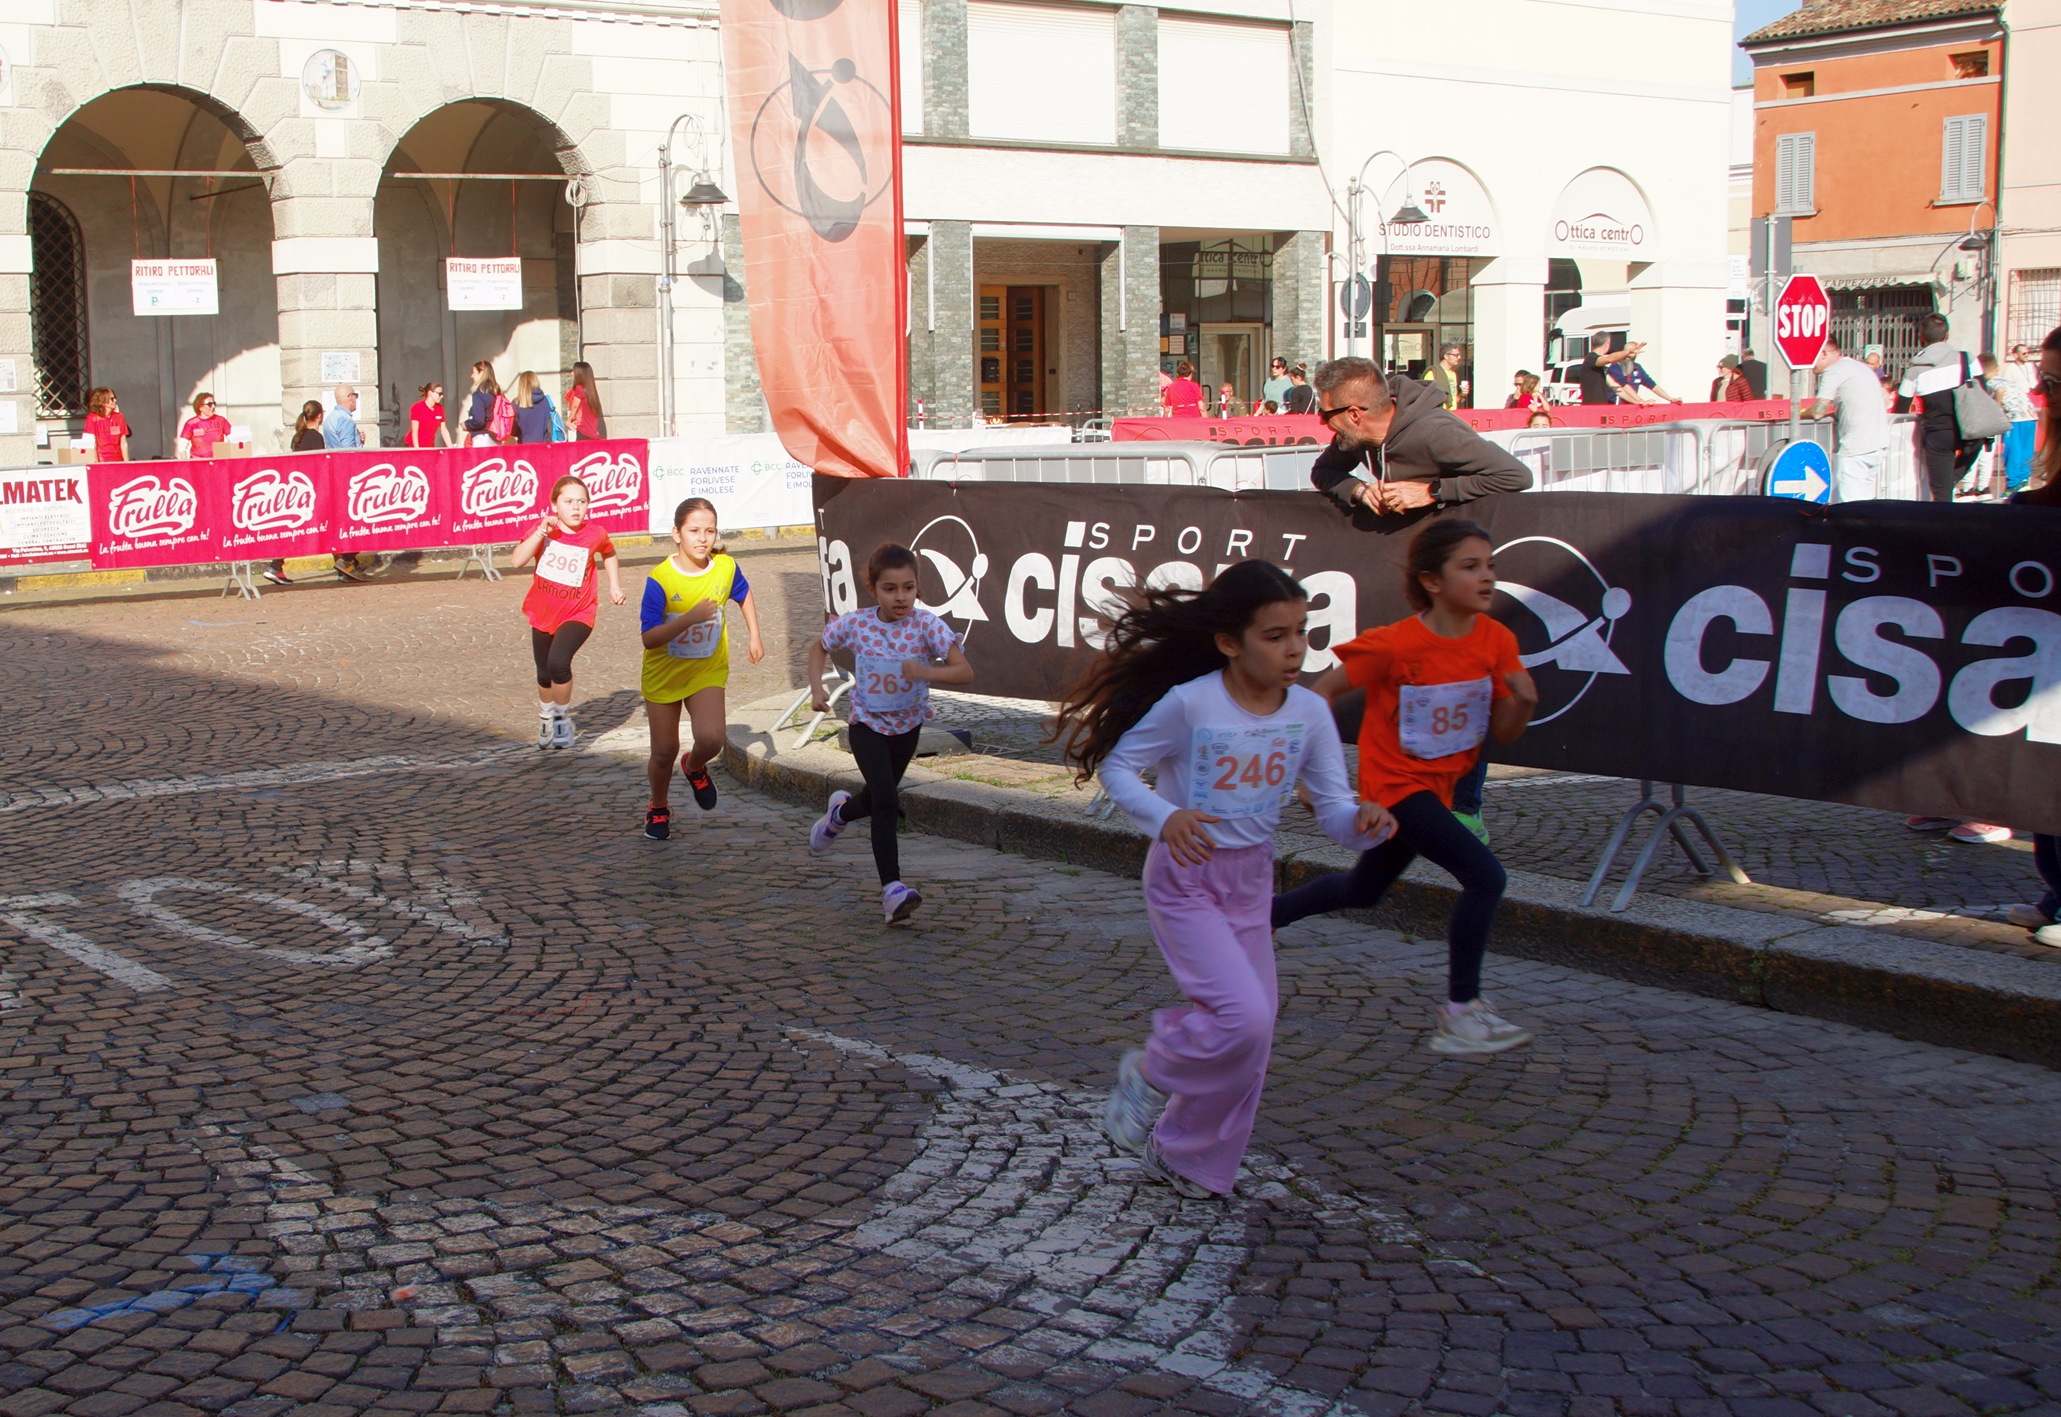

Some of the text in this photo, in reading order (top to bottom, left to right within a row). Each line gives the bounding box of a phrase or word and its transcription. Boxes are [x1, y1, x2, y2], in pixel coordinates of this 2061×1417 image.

[1378, 222, 1490, 239] STUDIO DENTISTICO
[1555, 219, 1595, 241] Ottica
[1417, 244, 1450, 252] Annamaria
[1451, 244, 1480, 252] Lombardi
[136, 265, 214, 277] RITIRO PETTORALI
[450, 262, 477, 273] RITIRO
[1823, 276, 1897, 288] TAPPEZZERIA
[1778, 304, 1827, 338] STOP
[1608, 414, 1668, 425] SPORT
[1218, 425, 1292, 437] SPORT
[667, 467, 684, 476] BCC
[690, 466, 740, 475] RAVENNATE
[690, 476, 735, 485] FORLIVESE
[0, 478, 83, 505] MATEK
[691, 486, 734, 495] E IMOLESE
[339, 528, 348, 539] La
[349, 525, 370, 537] frutta
[372, 522, 393, 535] buona
[394, 521, 419, 535] sempre
[419, 520, 431, 528] con
[453, 522, 461, 533] La
[462, 519, 483, 531] frutta
[484, 516, 504, 527] buona
[504, 515, 528, 527] sempre
[528, 513, 540, 521] con
[99, 542, 109, 555] La
[109, 541, 133, 553] frutta
[134, 537, 158, 549] buona
[159, 536, 185, 550] sempre
[186, 534, 200, 543] con
[223, 536, 232, 548] La
[233, 534, 256, 546] frutta
[257, 530, 279, 542] buona
[280, 529, 305, 543] sempre
[305, 527, 319, 536] con
[1089, 522, 1307, 561] SPORT
[546, 552, 579, 574] 296
[1842, 546, 2053, 599] SPO
[677, 623, 714, 645] 257
[1431, 703, 1469, 735] 85
[1212, 751, 1287, 791] 246
